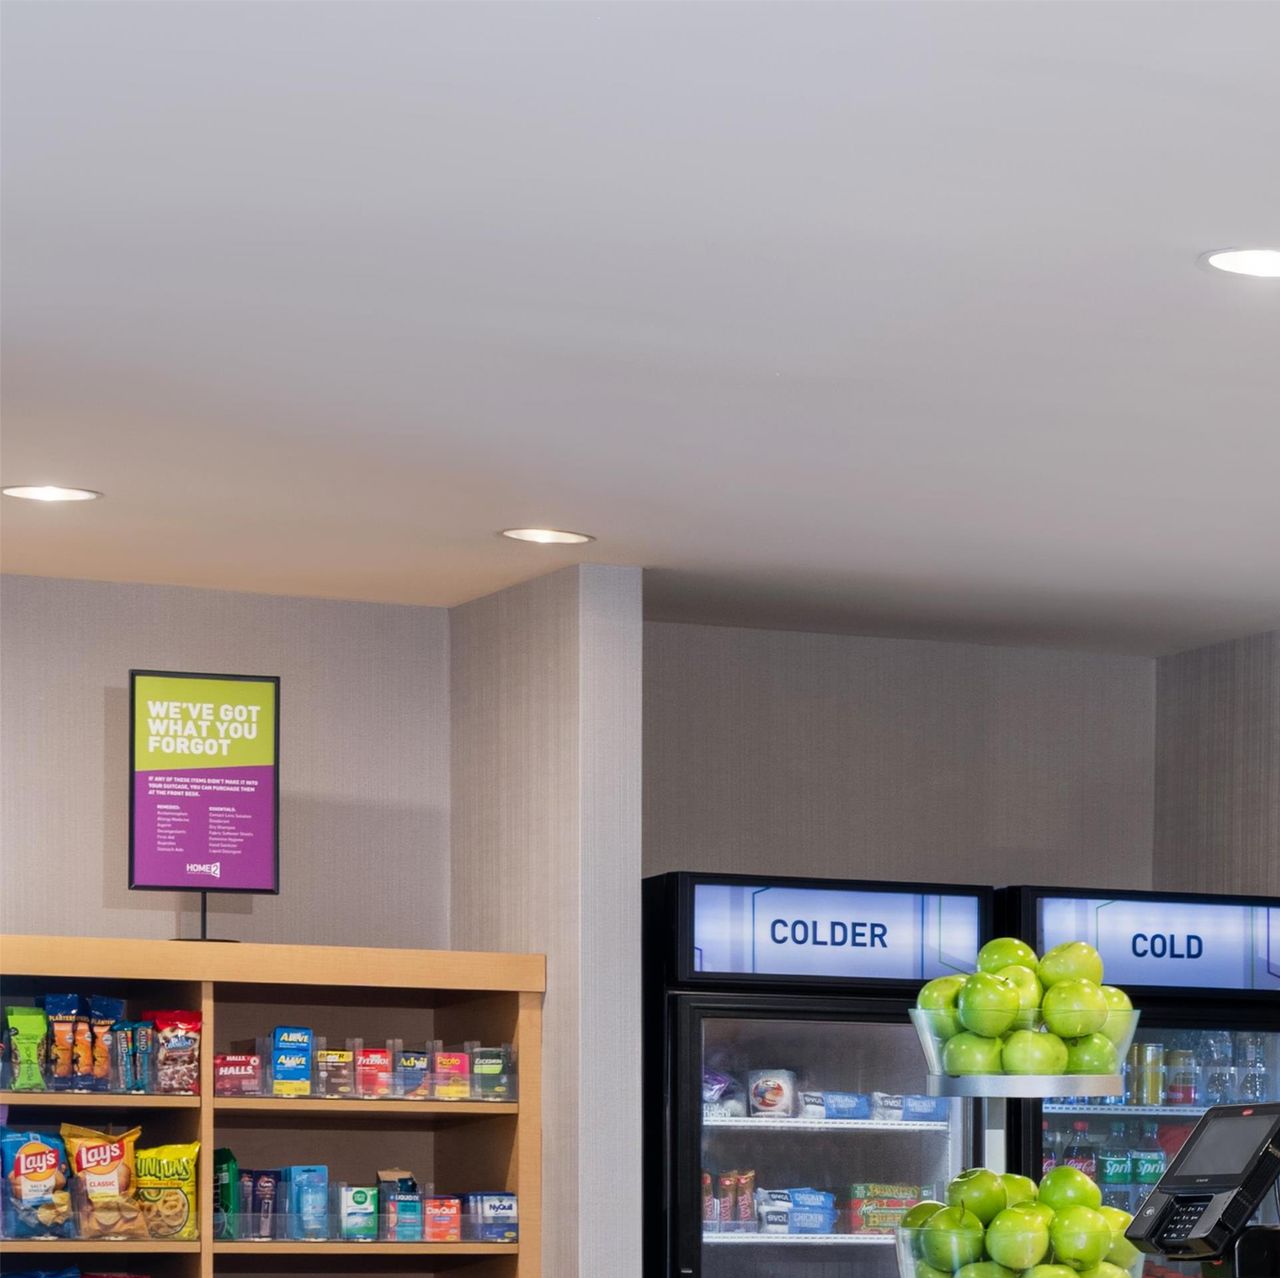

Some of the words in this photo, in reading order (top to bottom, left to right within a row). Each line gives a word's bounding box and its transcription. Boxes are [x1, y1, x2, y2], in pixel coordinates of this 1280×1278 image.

[147, 701, 214, 720] WE'VE
[220, 704, 261, 721] GOT
[148, 718, 211, 737] WHAT
[216, 721, 257, 739] YOU
[148, 736, 231, 756] FORGOT
[771, 918, 887, 949] COLDER
[1131, 933, 1203, 959] COLD
[219, 1066, 254, 1075] HALLS
[20, 1150, 55, 1174] Lay's
[137, 1157, 190, 1181] UNYUNS
[489, 1203, 513, 1212] NyQuil
